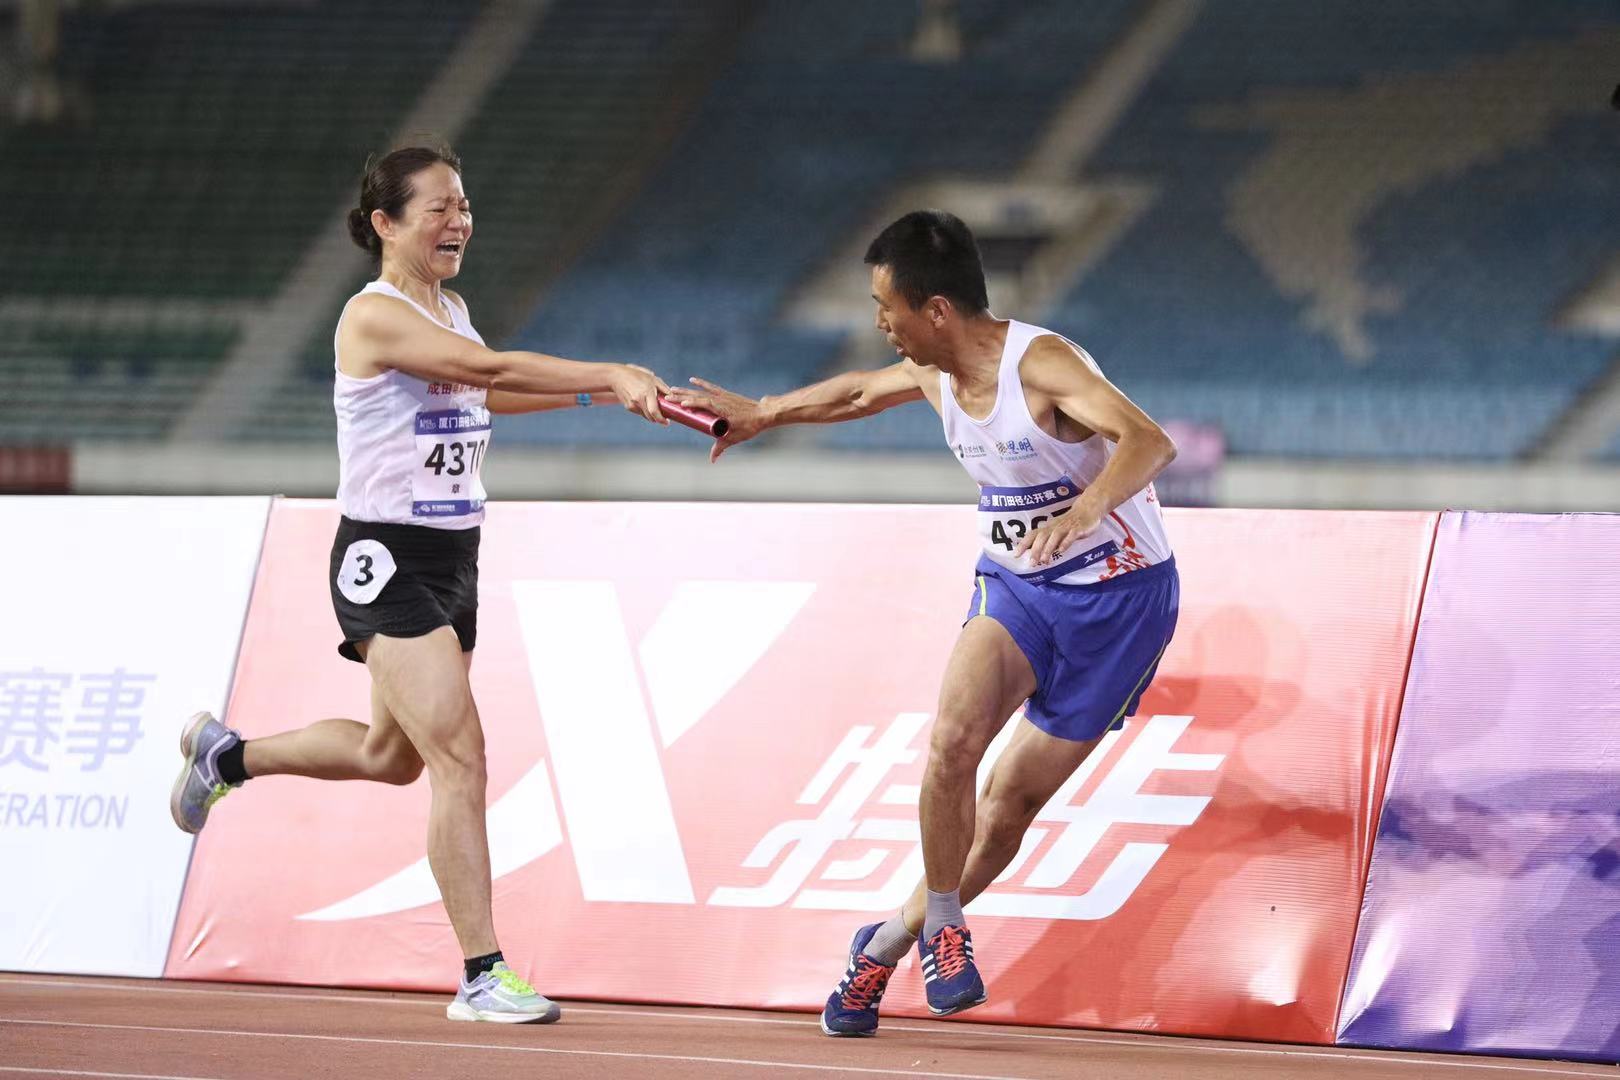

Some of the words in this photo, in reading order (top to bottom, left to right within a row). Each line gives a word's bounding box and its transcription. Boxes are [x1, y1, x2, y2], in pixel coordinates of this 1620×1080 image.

[424, 439, 485, 476] 4370
[991, 489, 1056, 507] 厦门田径公开赛
[991, 505, 1073, 551] 43
[353, 554, 374, 586] 3
[0, 666, 158, 772] 赛事
